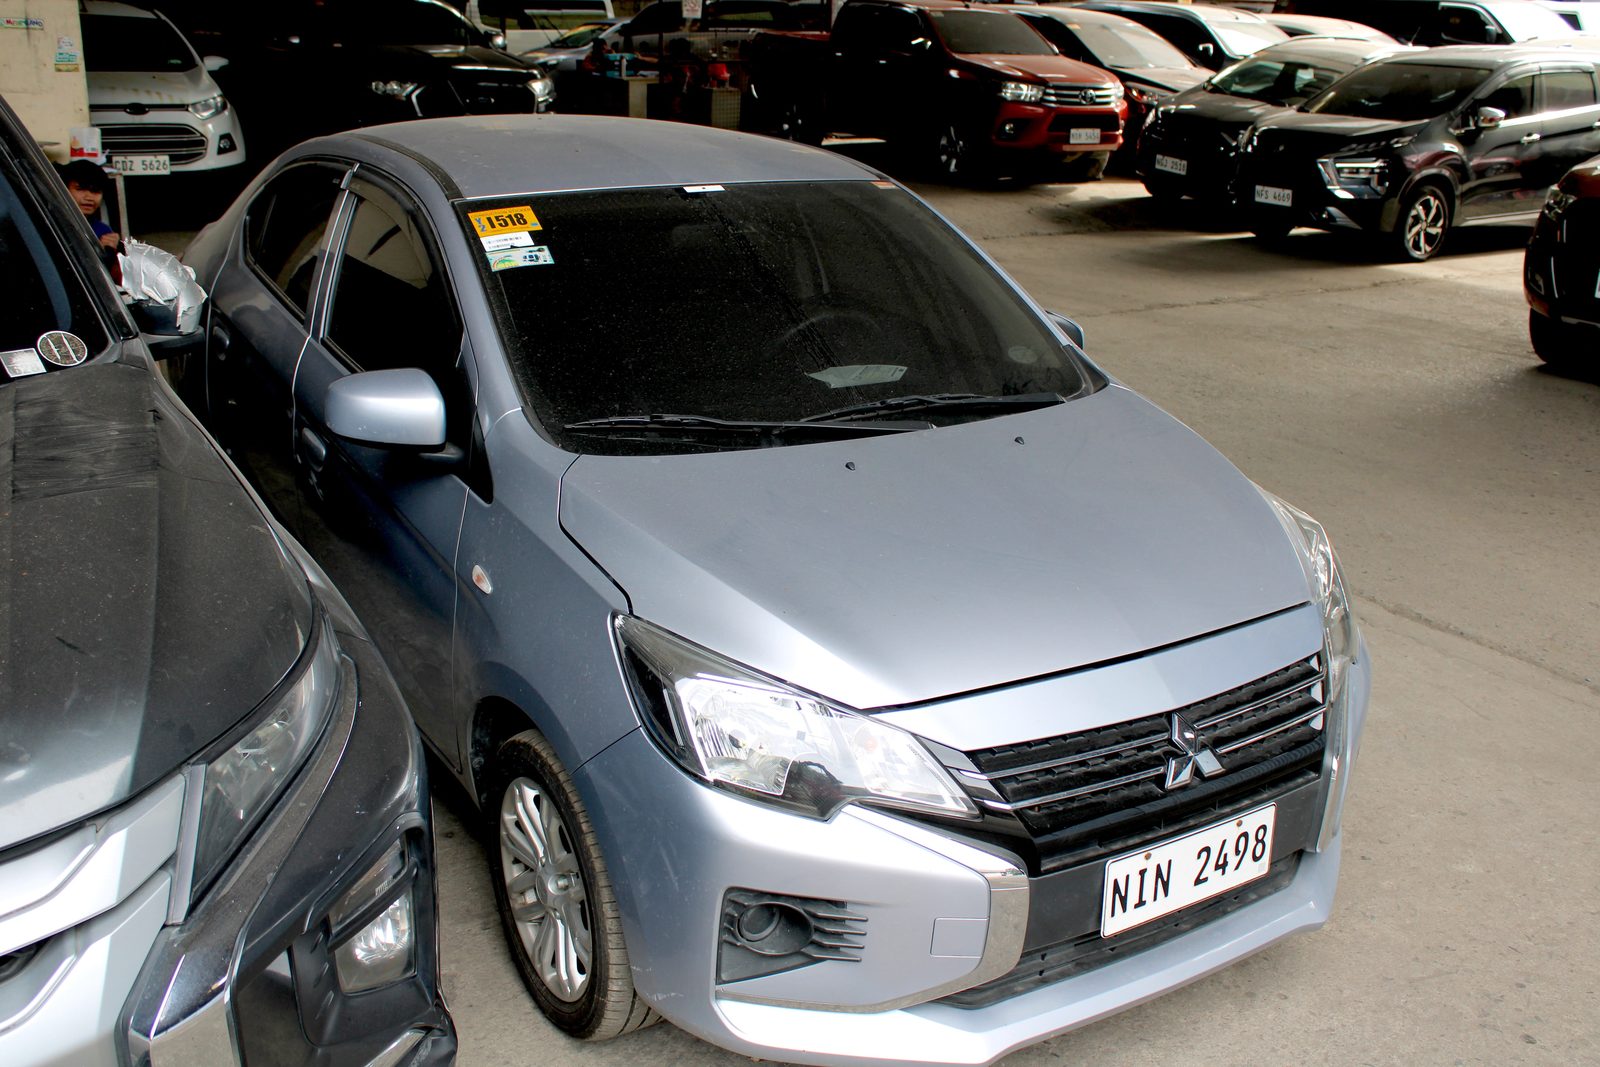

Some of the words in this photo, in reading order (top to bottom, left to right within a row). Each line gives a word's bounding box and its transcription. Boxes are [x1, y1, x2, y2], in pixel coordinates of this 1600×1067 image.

[114, 160, 134, 171] CDZ
[141, 159, 168, 171] 5626
[1256, 188, 1269, 200] NFS
[1273, 191, 1290, 203] 4669
[486, 212, 528, 229] 1518
[1111, 859, 1172, 918] NIN
[1193, 824, 1268, 887] 2498
